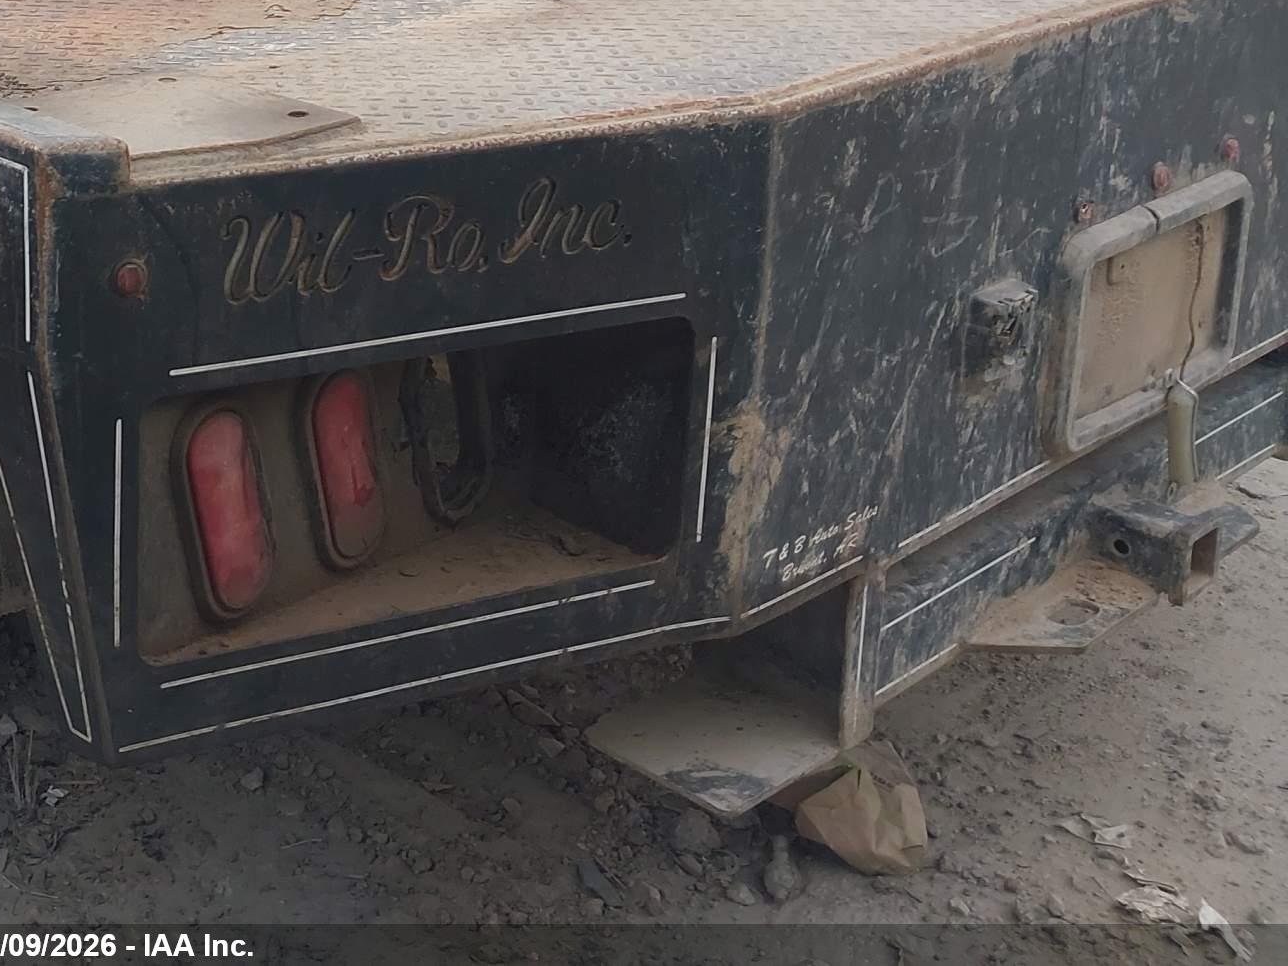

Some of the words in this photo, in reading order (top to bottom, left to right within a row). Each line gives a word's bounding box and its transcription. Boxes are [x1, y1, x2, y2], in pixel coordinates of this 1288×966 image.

[498, 177, 633, 265] Inc.
[762, 547, 779, 570] T
[778, 542, 790, 561] &
[794, 534, 808, 555] B
